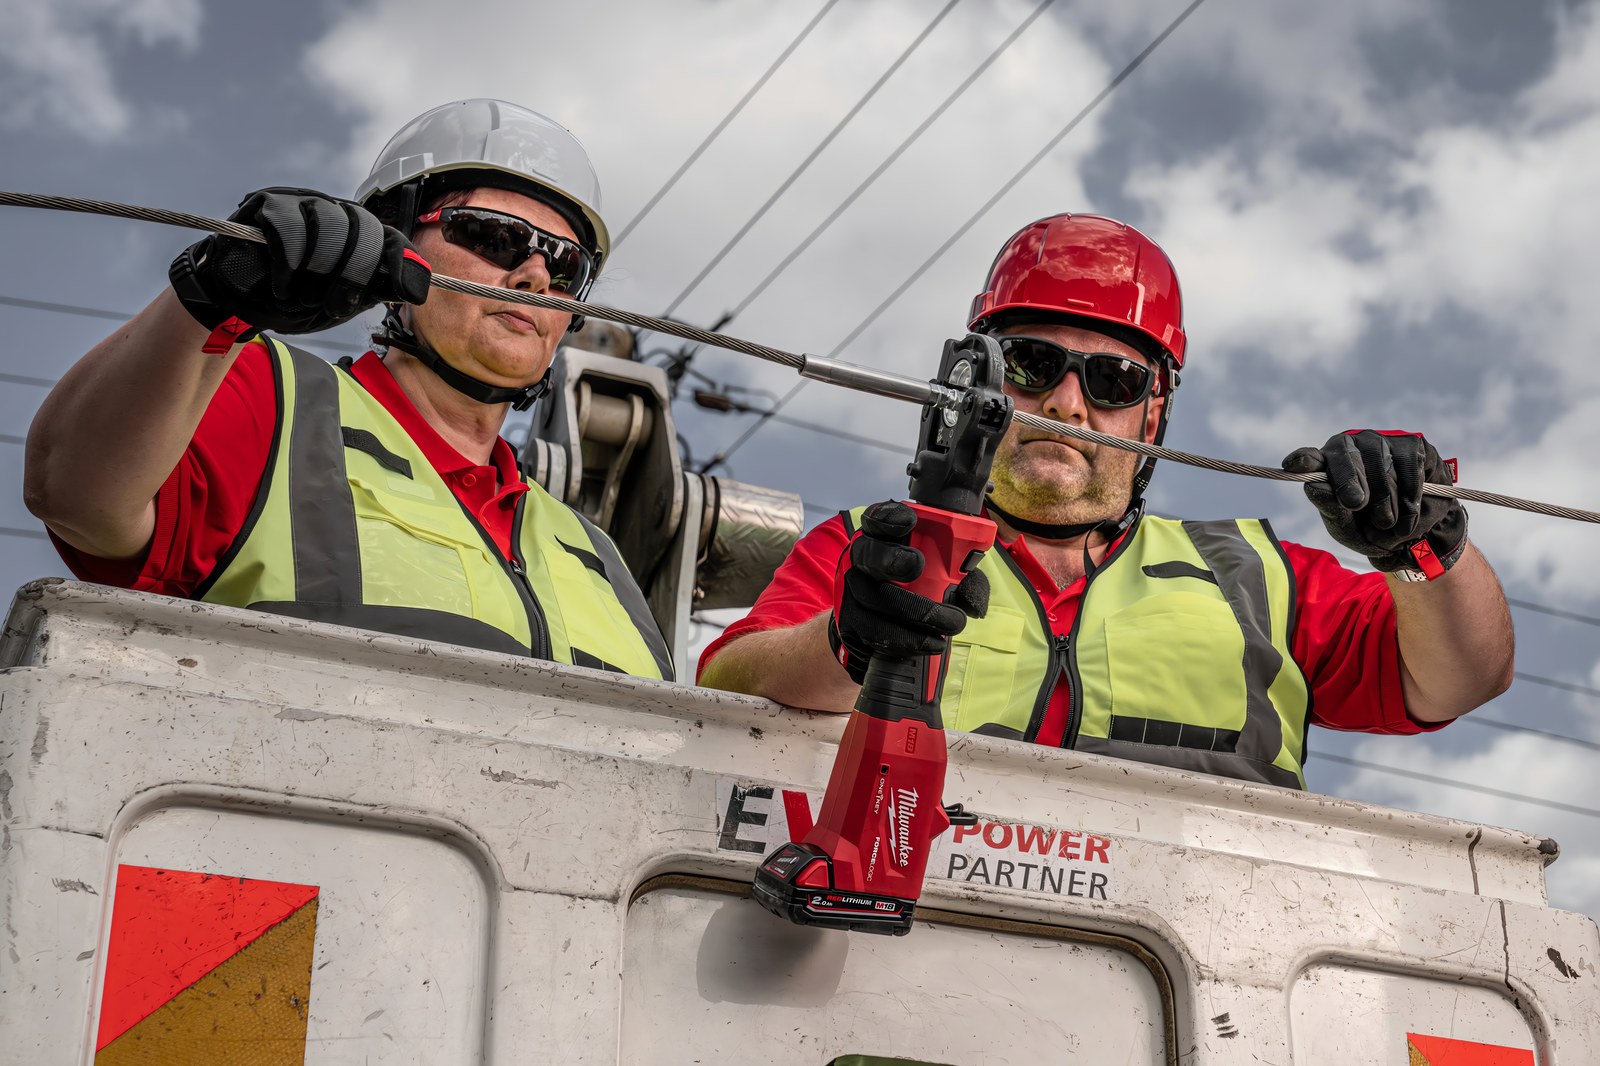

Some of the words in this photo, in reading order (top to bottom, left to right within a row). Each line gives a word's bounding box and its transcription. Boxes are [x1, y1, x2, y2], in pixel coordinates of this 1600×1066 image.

[907, 727, 917, 753] M18
[897, 786, 919, 868] Milwaukee
[953, 821, 1112, 864] POWER
[947, 853, 1109, 900] PARTNER
[826, 895, 873, 906] REDLITHIUM
[875, 901, 896, 911] M18
